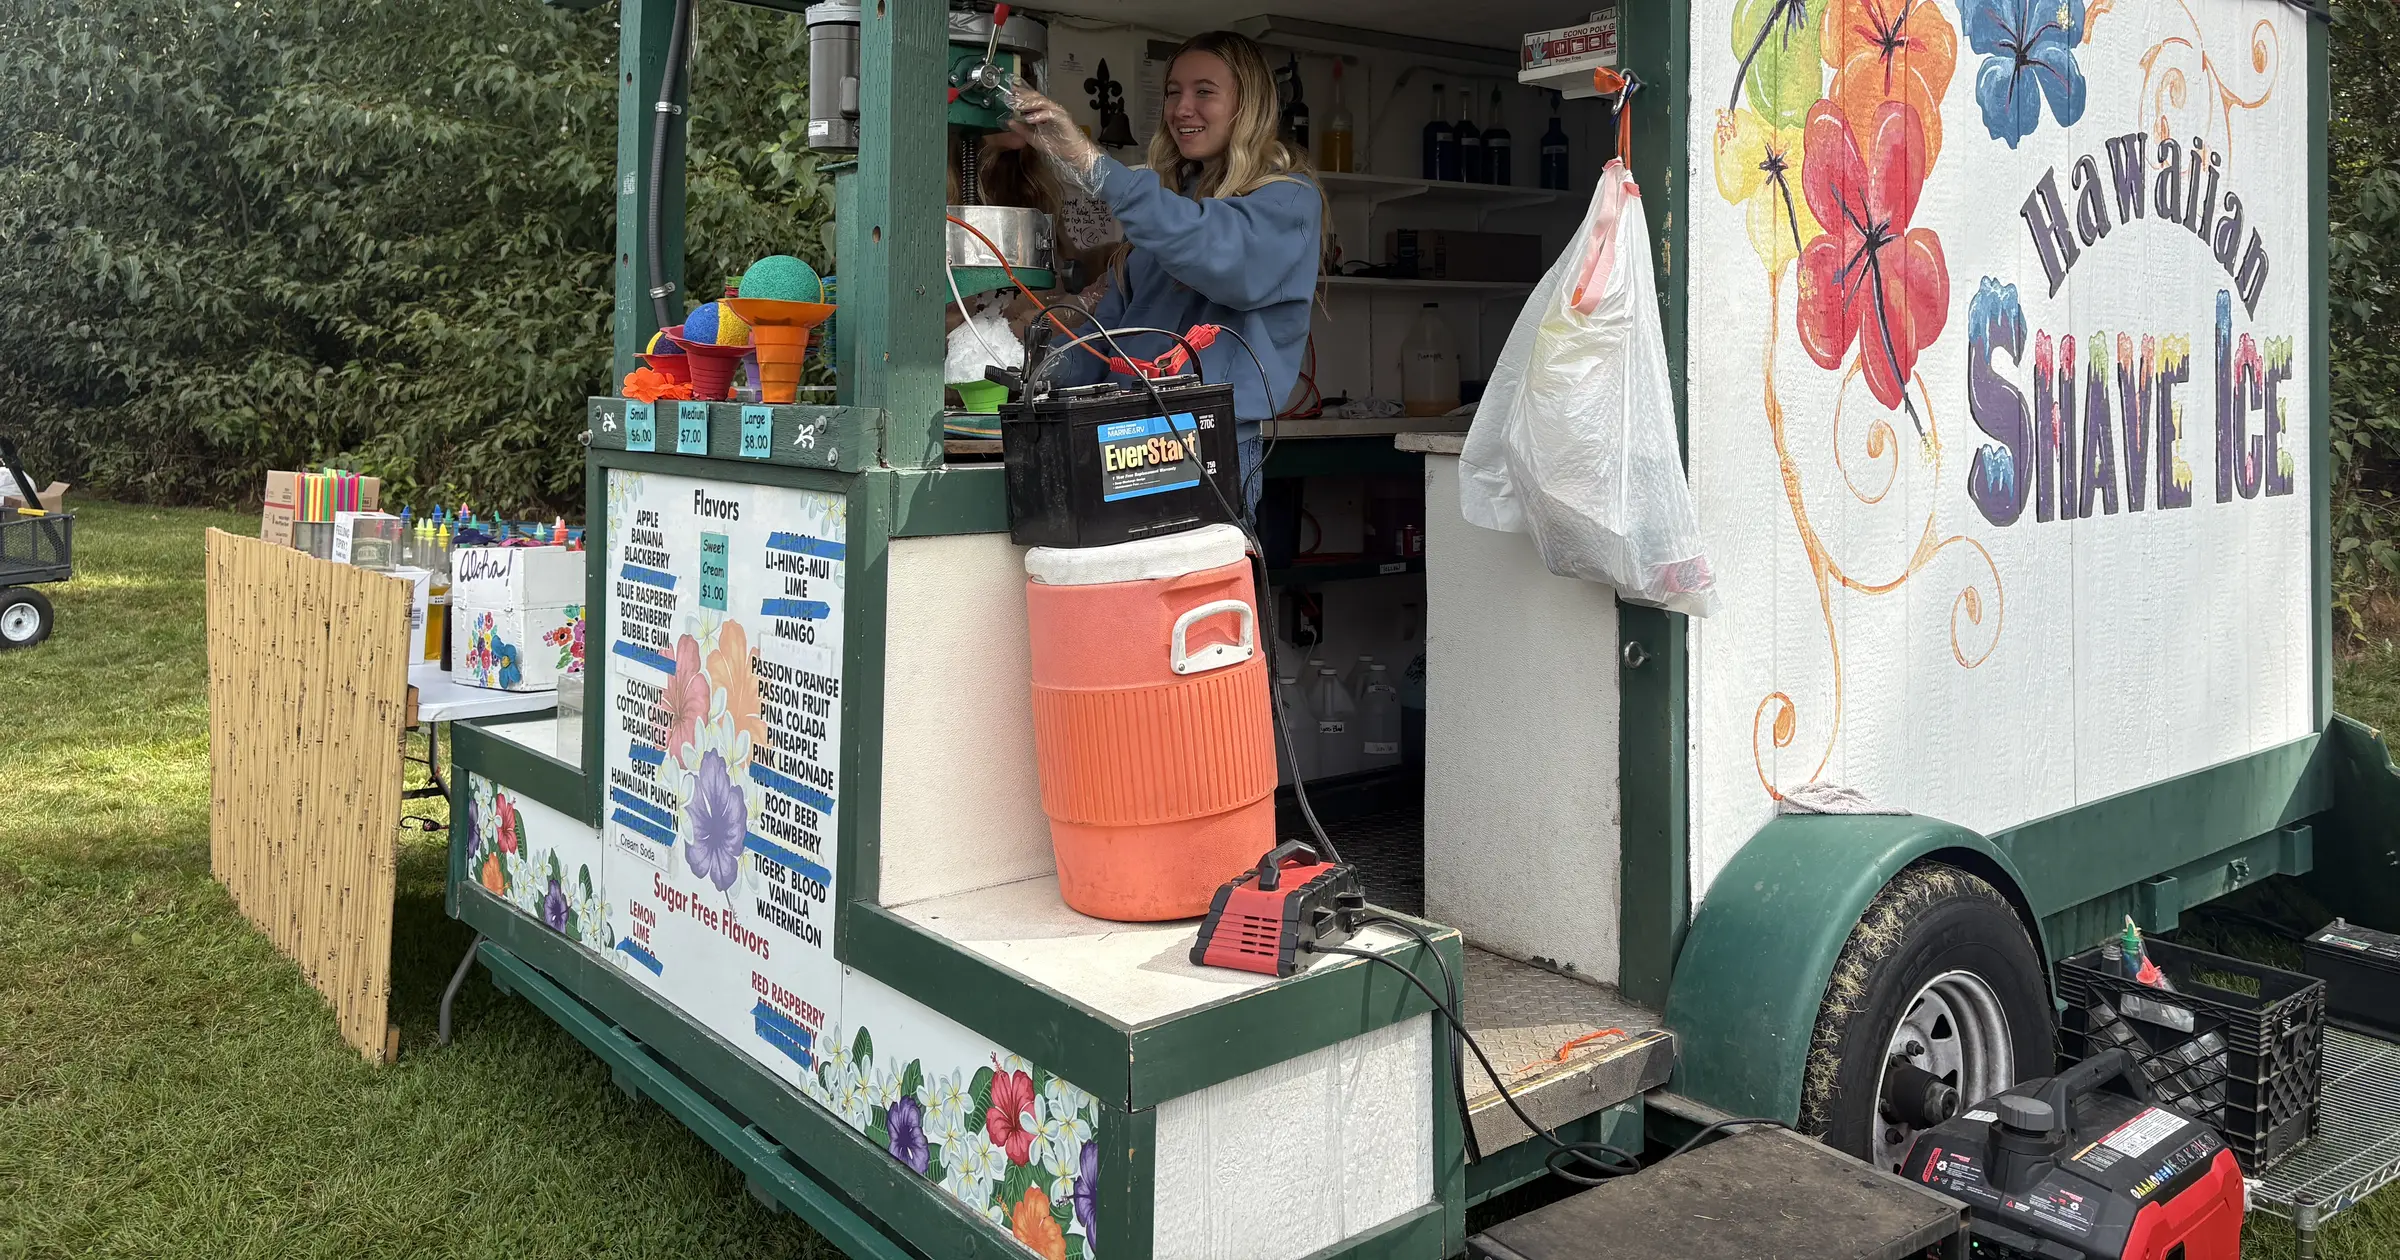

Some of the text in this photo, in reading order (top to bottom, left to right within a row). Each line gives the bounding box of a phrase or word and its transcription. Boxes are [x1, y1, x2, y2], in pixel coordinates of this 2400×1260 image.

[1563, 27, 1588, 38] ECONO
[1589, 23, 1607, 34] POLY
[2020, 132, 2269, 322] Hawaiian
[629, 407, 648, 422] Small
[680, 407, 706, 422] Medium
[1967, 276, 2294, 527] SHAVE ICE
[744, 410, 766, 426] Large
[1200, 419, 1215, 430] 27DC
[631, 429, 652, 444] $6.00
[680, 429, 702, 444] $7.00
[744, 434, 768, 451] $8.00
[1104, 431, 1197, 472] EverStart
[636, 509, 659, 529] APPLE
[694, 489, 740, 521] Flavors
[631, 528, 663, 549] BANANA
[702, 538, 725, 555] Sweet
[460, 549, 513, 587] Aloha!
[624, 546, 670, 570] BLACKBERRY
[702, 563, 725, 578] Cream
[765, 551, 830, 580] LI-HING-MUI
[616, 581, 678, 612] BLUE RASPBERRY
[702, 586, 724, 601] $1.00
[784, 576, 808, 598] LIME
[620, 602, 672, 630] BOYSENBERRY
[621, 621, 670, 649] BUBBLE GUM
[775, 618, 815, 645] MANGO
[751, 656, 839, 698] PASSION ORANGE
[626, 679, 663, 705] COCONUT
[758, 679, 830, 719] PASSION FRUIT
[616, 694, 674, 730] COTTON CANDY
[760, 702, 826, 741] PINA COLADA
[622, 715, 666, 747] DREAMSICLE
[766, 727, 818, 762] PINEAPPLE
[631, 758, 656, 780] GRAPE
[752, 744, 834, 791] PINK LEMONADE
[611, 767, 648, 798] HAWAIIAN
[650, 787, 677, 811] PUNCH
[765, 792, 818, 831] ROOT BEER
[620, 833, 656, 861] Cream Soda
[760, 812, 821, 855] STRAWBERRY
[754, 853, 786, 884] TIGERS
[791, 869, 826, 904] BLOOD
[629, 898, 656, 929] LEMON
[768, 882, 809, 919] VANILLA
[653, 872, 769, 960] Sugar Free Flavors
[756, 897, 822, 949] WATERMELON
[633, 920, 650, 944] LIME
[751, 970, 825, 1031] RED RASPBERRY
